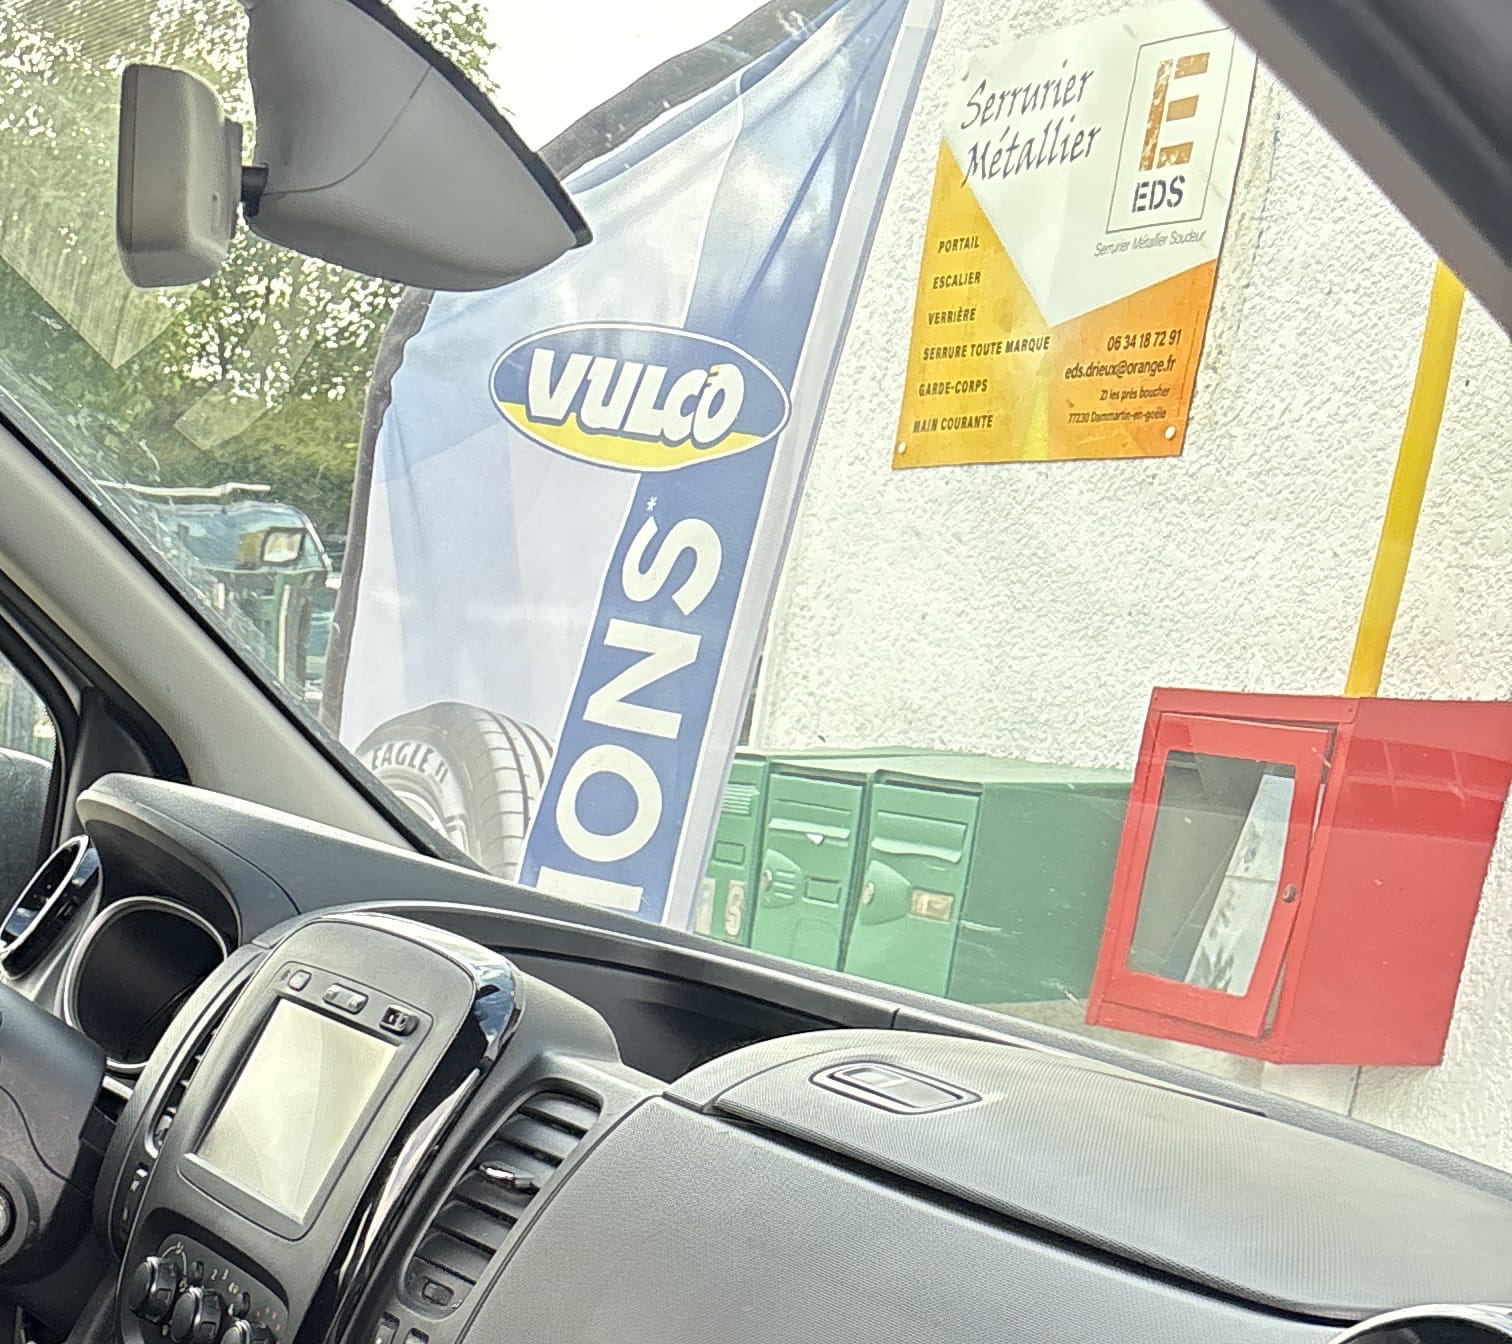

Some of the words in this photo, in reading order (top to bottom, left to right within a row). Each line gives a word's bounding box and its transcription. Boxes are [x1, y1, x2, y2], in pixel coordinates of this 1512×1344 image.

[960, 59, 1094, 130] Serrurier
[960, 114, 1102, 188] Métallier
[1131, 175, 1186, 213] EDS
[938, 236, 980, 253] PORTAIL
[932, 271, 982, 289] ESCALIER
[928, 307, 977, 325] VERRIÈRE
[923, 345, 968, 360] SERRURE
[970, 341, 1003, 356] TOUTE
[1005, 336, 1051, 353] MARQUE
[1106, 336, 1122, 352] 06
[1123, 334, 1137, 350] 34
[1139, 332, 1152, 349] 18
[1153, 330, 1167, 347] 72
[1168, 329, 1182, 345] 91
[528, 348, 745, 444] VULCO
[919, 379, 988, 396] GARDE-CORPS
[913, 420, 938, 433] MAIN
[940, 415, 994, 431] COURANTE
[371, 742, 435, 773] EAGLE
